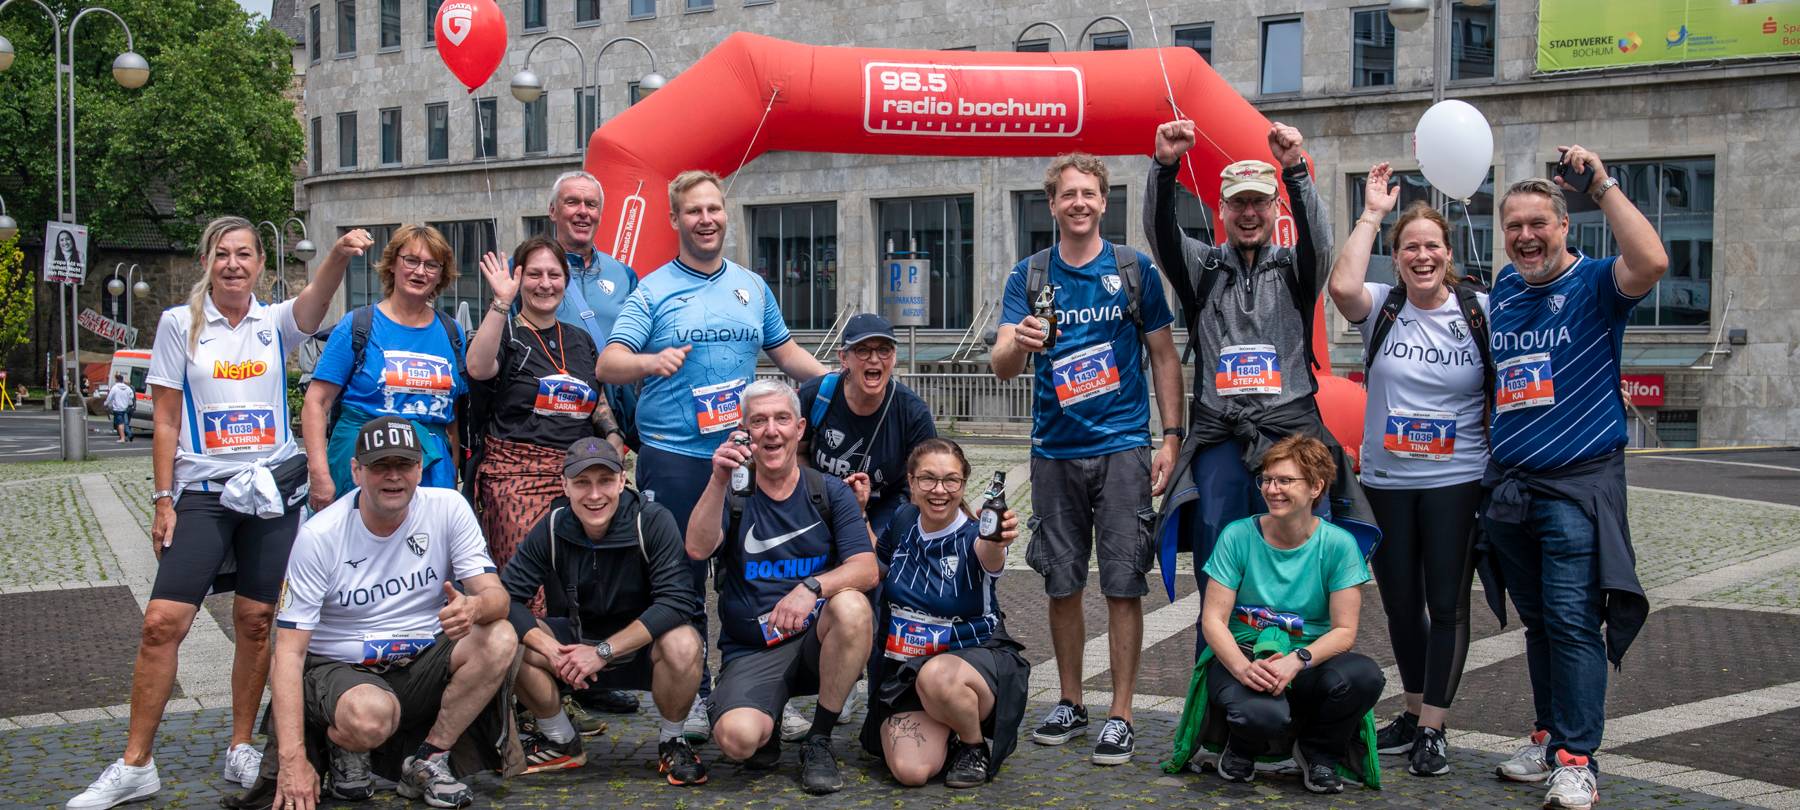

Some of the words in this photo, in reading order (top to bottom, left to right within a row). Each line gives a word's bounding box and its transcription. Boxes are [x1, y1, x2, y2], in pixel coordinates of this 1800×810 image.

[1549, 36, 1614, 49] STADTWERKE
[1572, 47, 1614, 58] BOCHUM
[880, 71, 948, 92] 98.5
[883, 96, 953, 115] radio
[957, 97, 1067, 117] bochum
[1055, 305, 1123, 325] ONOVIA
[676, 328, 760, 343] VONOVIA
[213, 360, 267, 380] Netto
[408, 369, 429, 378] 1947
[1076, 369, 1097, 384] 1430
[1237, 366, 1260, 376] 1848
[405, 378, 432, 387] STEFFI
[1072, 378, 1106, 395] NICOLAS
[1232, 377, 1265, 386] STEFAN
[1508, 378, 1527, 391] 1033
[1511, 391, 1524, 400] KAI
[1629, 381, 1660, 397] ifon
[553, 402, 577, 411] SARAH
[719, 402, 737, 413] 1605
[718, 411, 739, 423] ROBIN
[227, 422, 253, 435] 1038
[221, 434, 261, 445] KATHRIN
[364, 428, 414, 451] ICON
[1408, 431, 1433, 442] 1036
[1410, 443, 1430, 451] TINA
[744, 554, 828, 580] BOCHUM
[338, 566, 439, 607] VONOVIA
